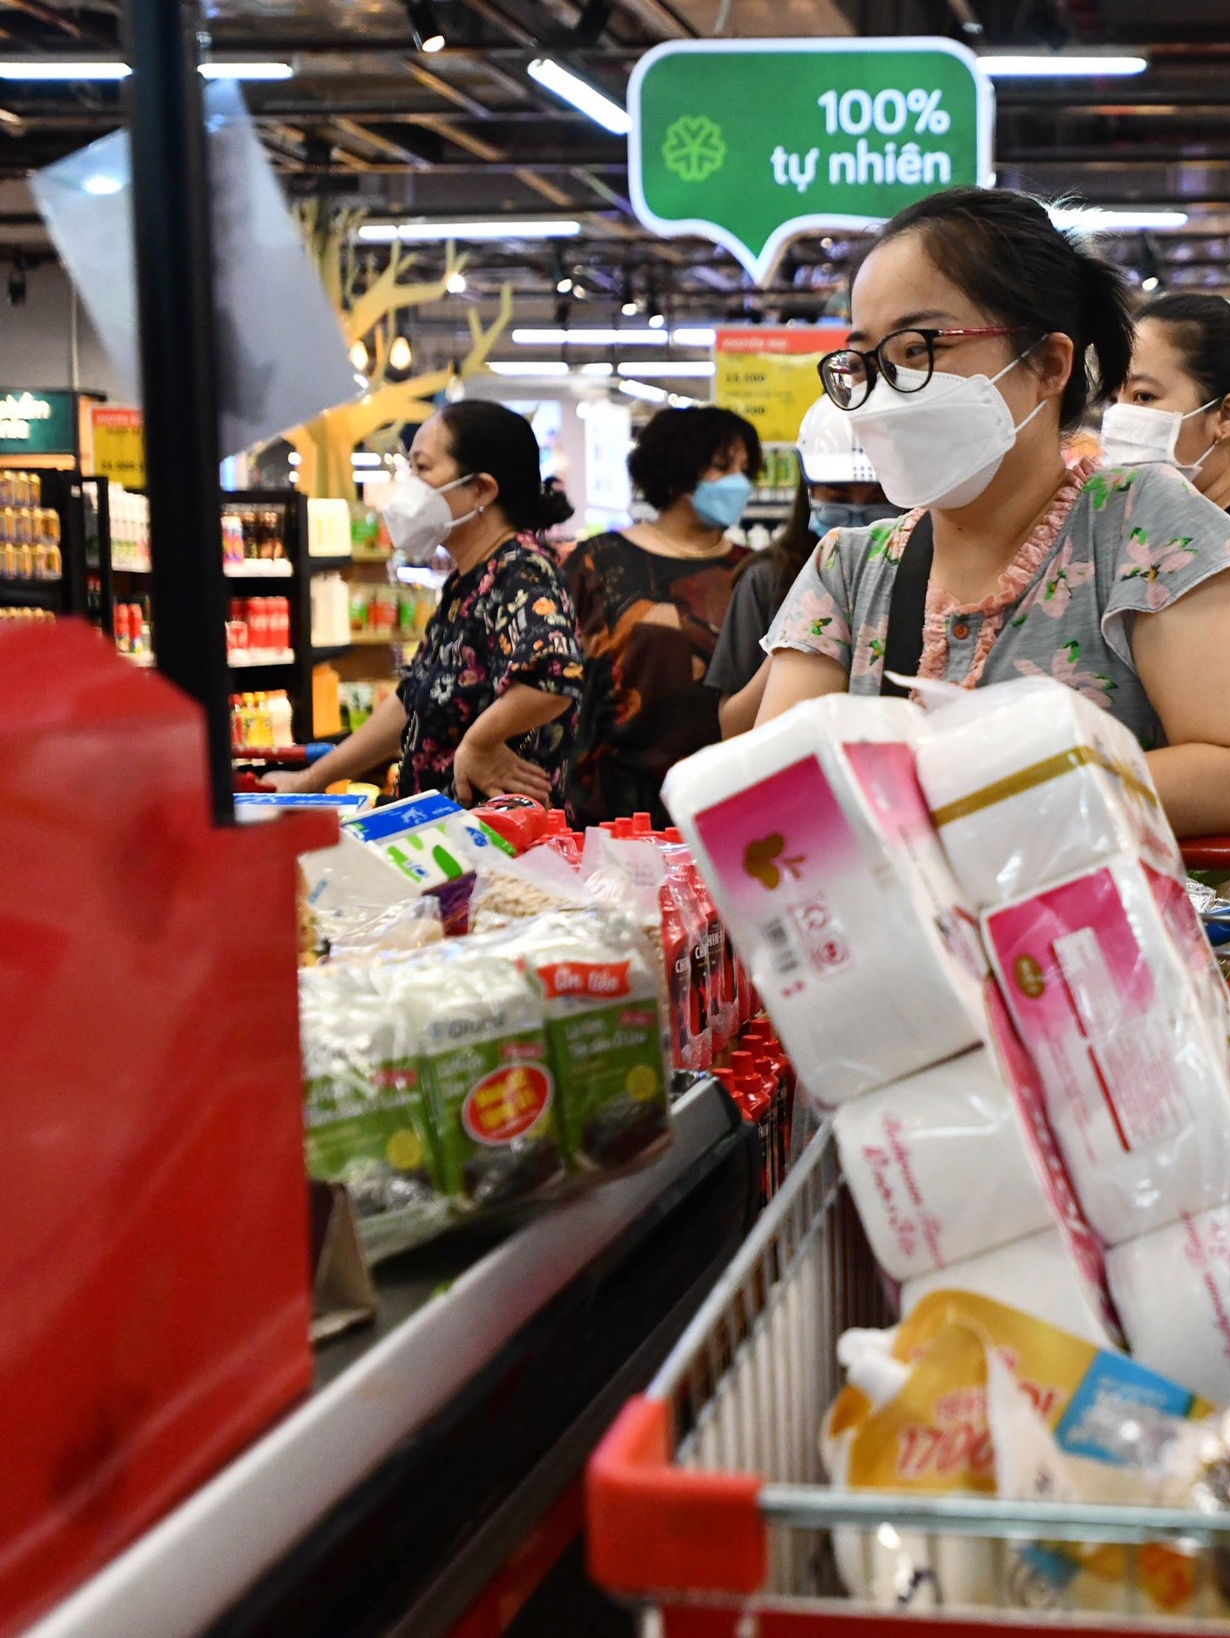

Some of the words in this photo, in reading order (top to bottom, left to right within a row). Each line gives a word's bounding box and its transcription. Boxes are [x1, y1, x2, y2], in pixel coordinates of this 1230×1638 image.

[818, 88, 951, 136] 100%
[770, 146, 820, 193] tự
[828, 139, 952, 185] nhiên
